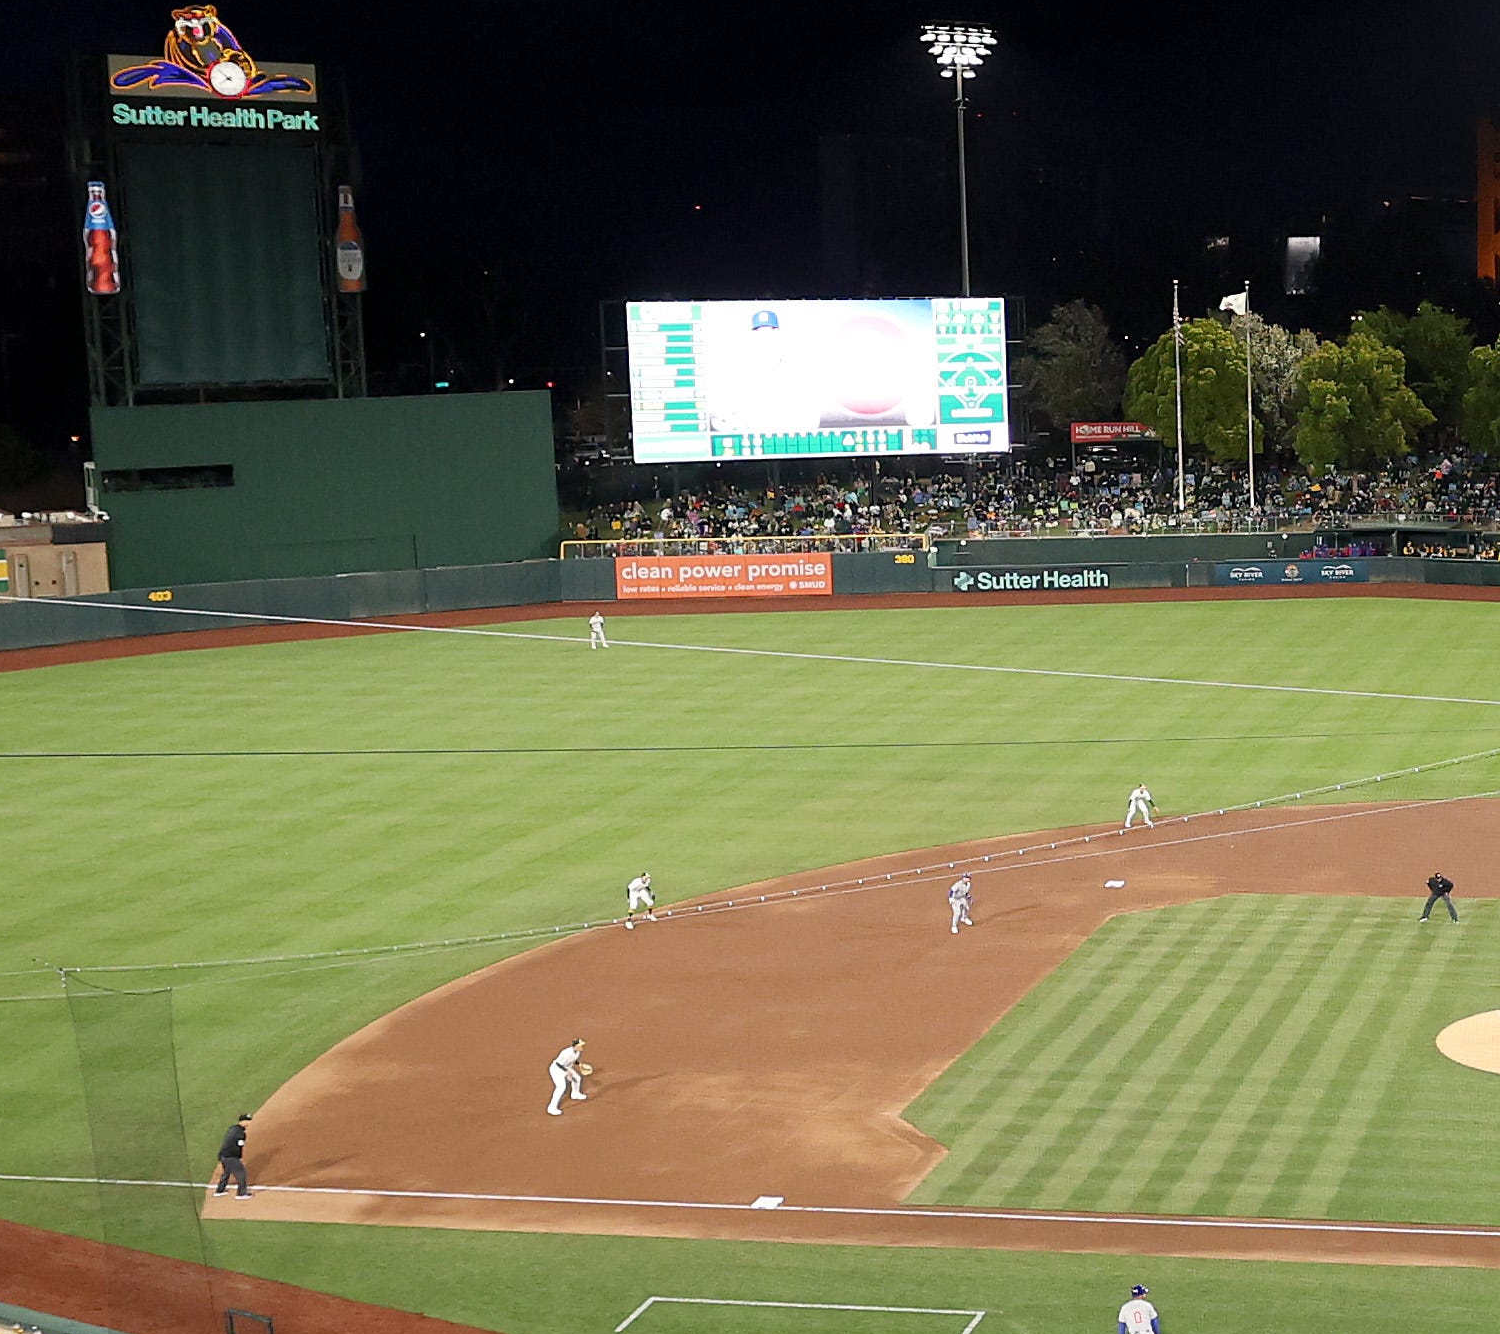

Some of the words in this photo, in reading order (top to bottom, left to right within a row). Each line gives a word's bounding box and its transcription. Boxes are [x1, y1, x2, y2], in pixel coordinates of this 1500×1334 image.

[112, 103, 188, 128] Sutter
[190, 106, 265, 129] Health
[267, 110, 319, 131] Park
[894, 555, 914, 564] 380
[622, 563, 672, 580] clean
[679, 564, 741, 582] power
[748, 559, 825, 581] promise
[622, 585, 638, 593] low
[640, 584, 659, 593] rates
[667, 583, 697, 592] reliable
[699, 584, 725, 592] service
[734, 582, 754, 591] clean
[756, 583, 784, 592] energy
[977, 572, 1040, 590] Sutter
[1044, 570, 1108, 587] Health
[1134, 1311, 1142, 1323] 0
